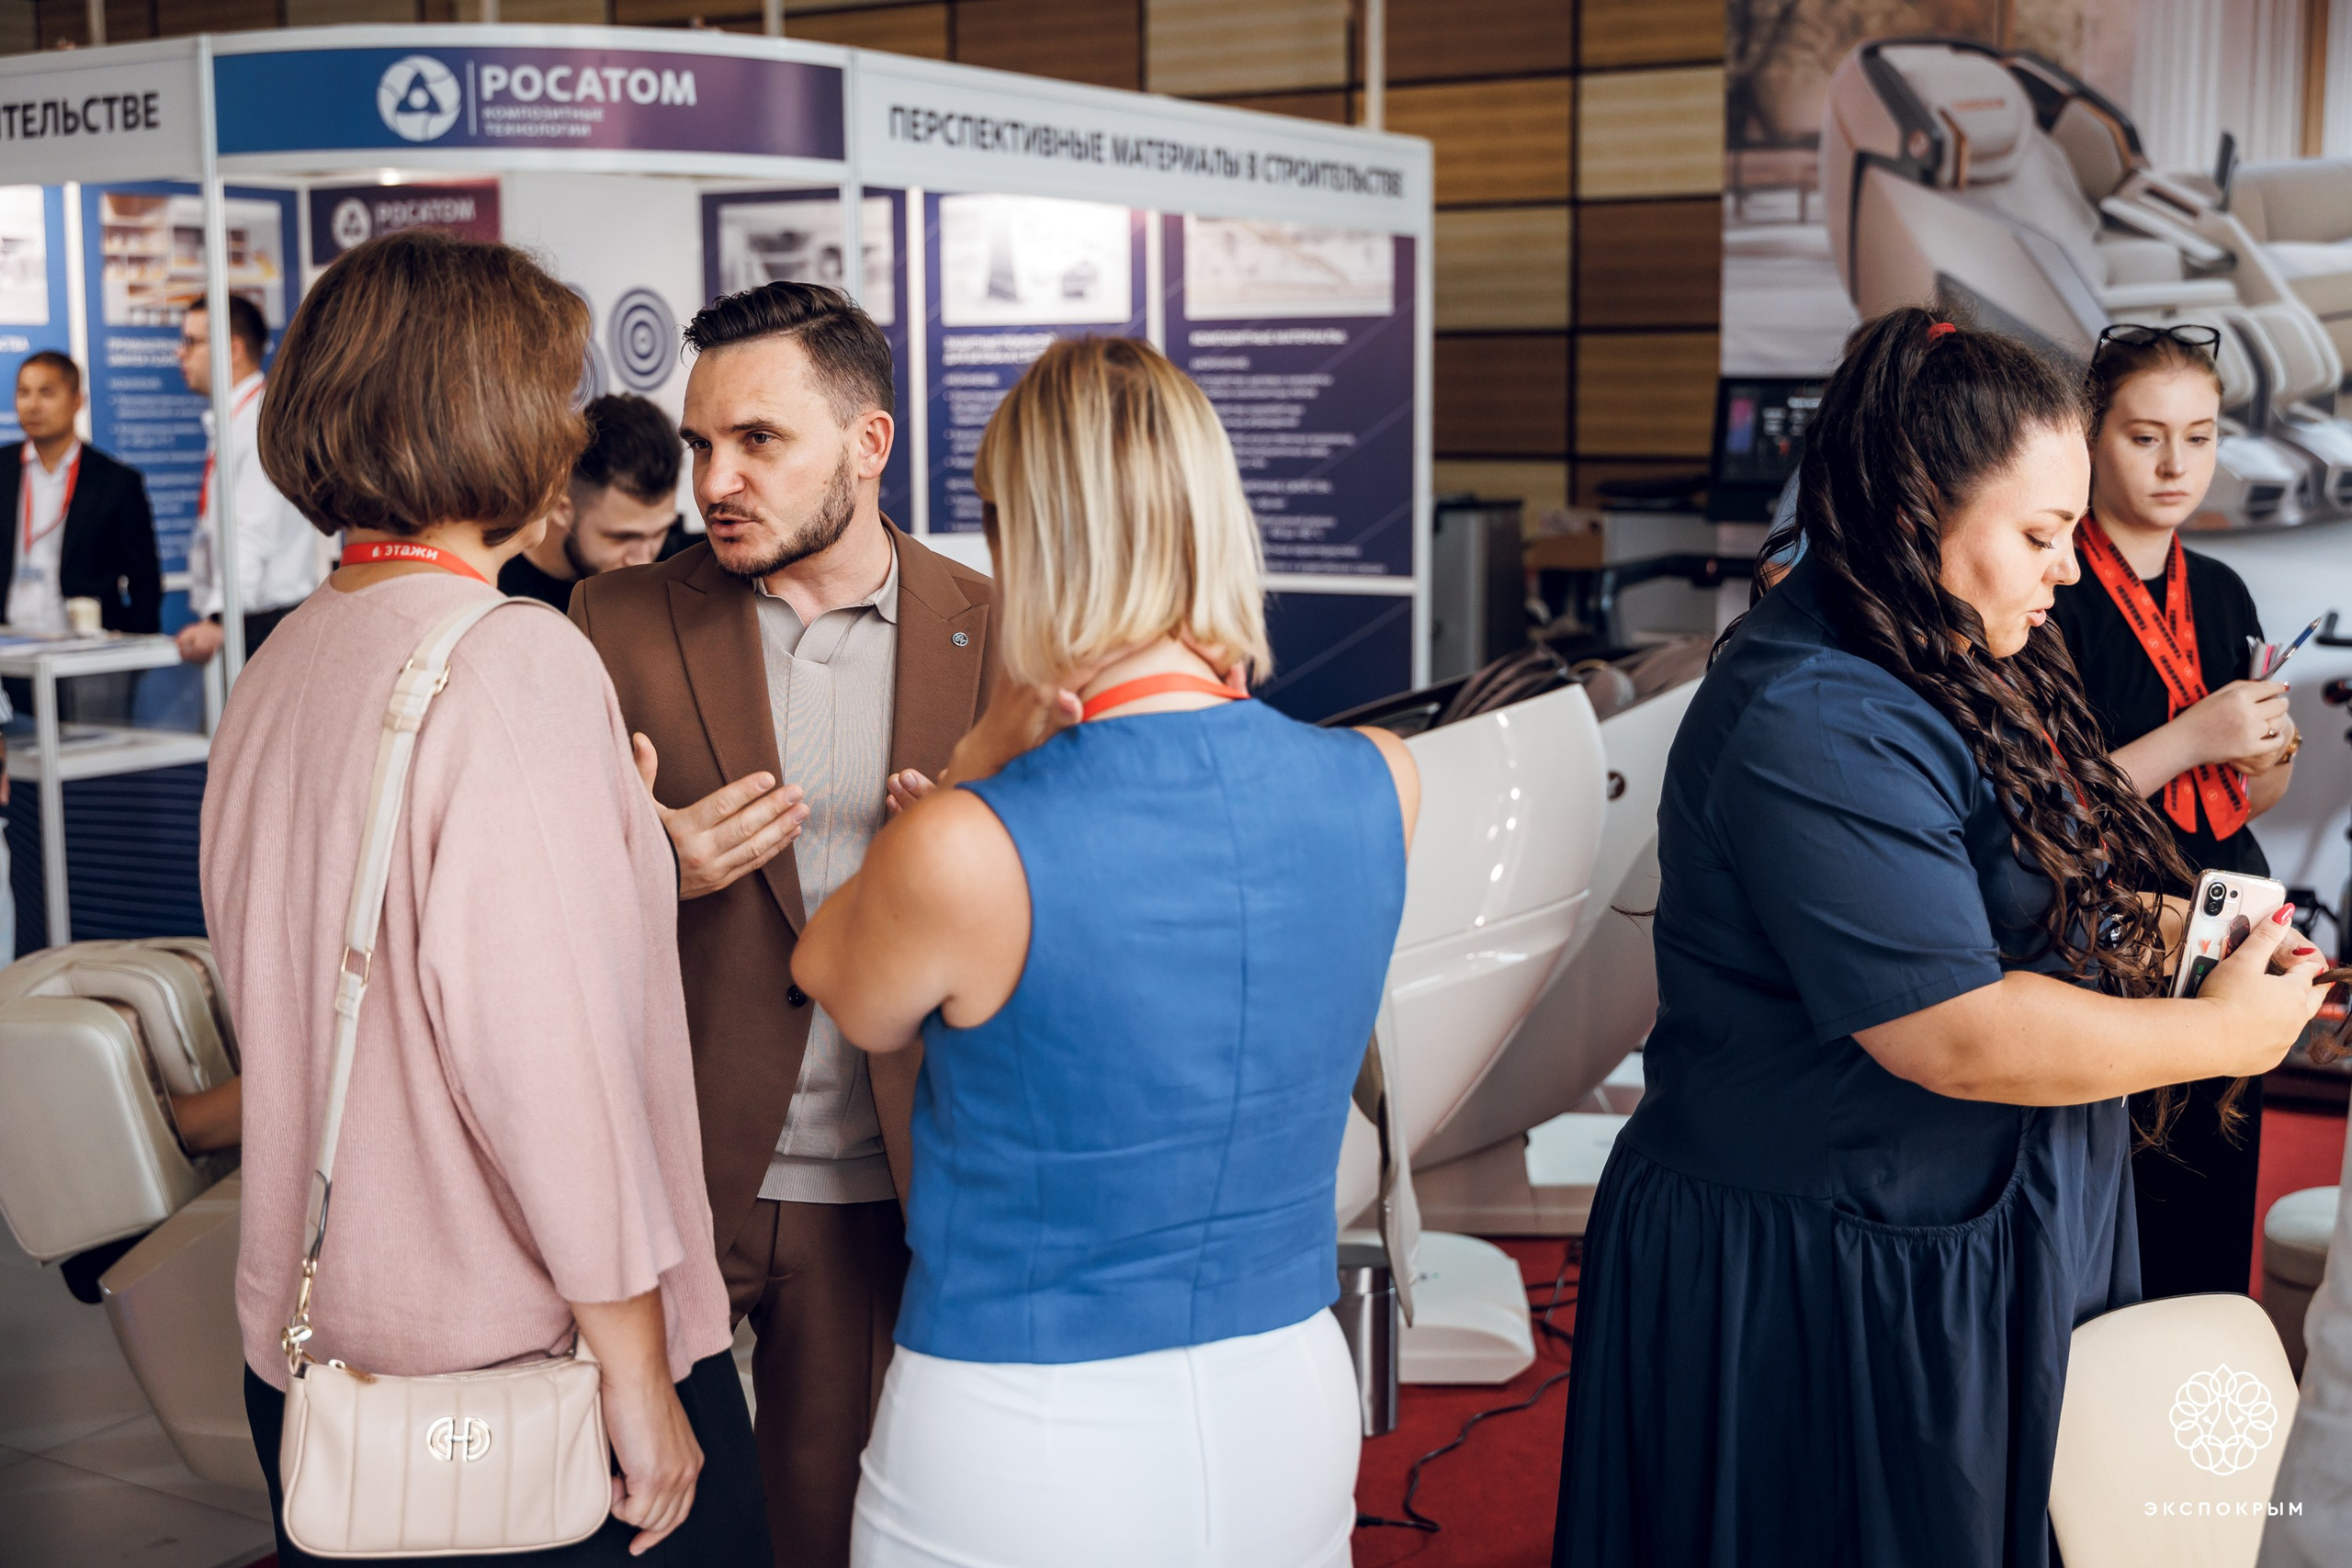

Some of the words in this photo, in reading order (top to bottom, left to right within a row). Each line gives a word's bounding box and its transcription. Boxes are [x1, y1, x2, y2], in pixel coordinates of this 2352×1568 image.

[481, 64, 697, 107] РОСАТОМ
[0, 90, 161, 140] ТЕЛЬСТВЕ
[888, 105, 1104, 164] ПЕРСПЕКТИВНЫЕ
[1110, 135, 1239, 178] МАТЕРИАЛЫ
[1247, 152, 1259, 181] В
[1263, 152, 1404, 198] СТРОИТЕЛЬСТВЕ
[376, 197, 476, 226] РОСАТОМ
